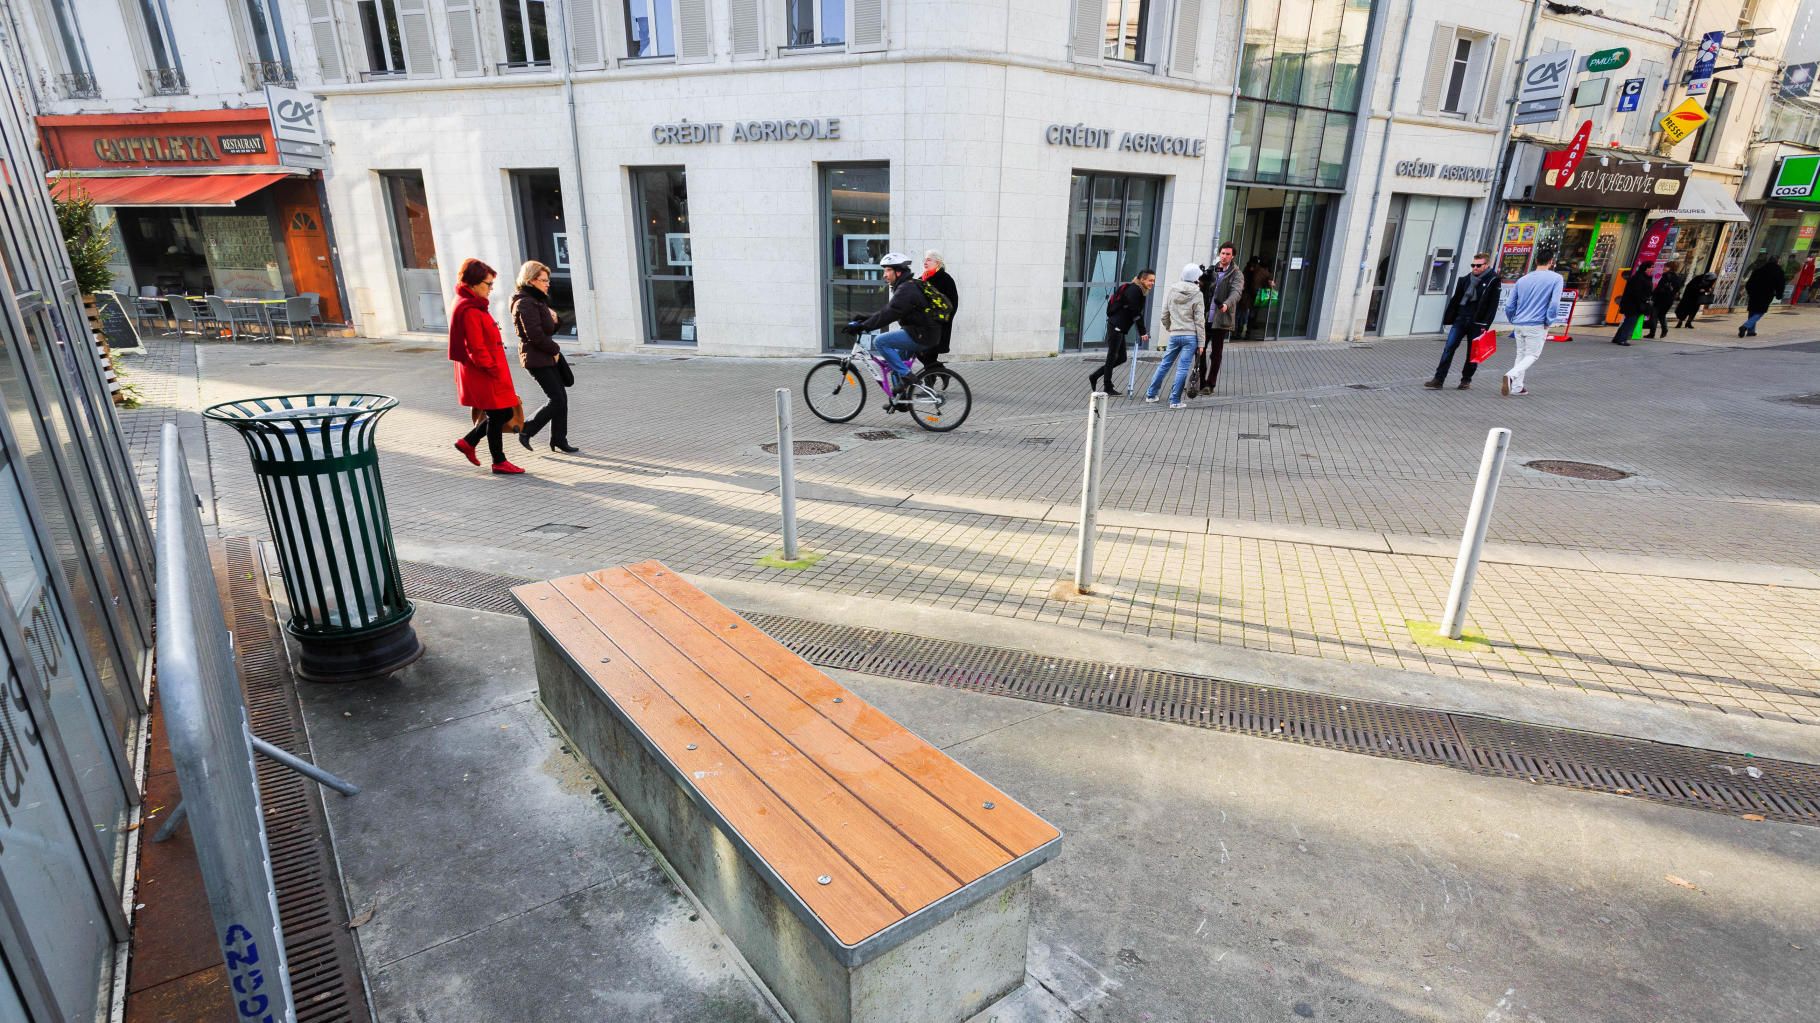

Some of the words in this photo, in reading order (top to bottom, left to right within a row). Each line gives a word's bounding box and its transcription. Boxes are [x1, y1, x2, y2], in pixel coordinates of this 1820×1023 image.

[1590, 57, 1610, 67] PMU
[651, 118, 723, 145] CRÉDIT
[731, 118, 841, 143] AGRICOLE
[1663, 117, 1684, 138] PRESSE
[92, 135, 220, 163] CATTLEYA
[222, 137, 261, 149] RESTAURANT
[1045, 122, 1115, 150] CRÉDIT
[1119, 132, 1206, 158] AGRICOLE
[1561, 134, 1585, 176] TABAC
[1396, 157, 1439, 178] CRÉDIT
[1437, 164, 1496, 183] AGRICOLE
[1574, 169, 1600, 191] AU
[1775, 186, 1807, 196] casa
[1512, 245, 1531, 253] Point
